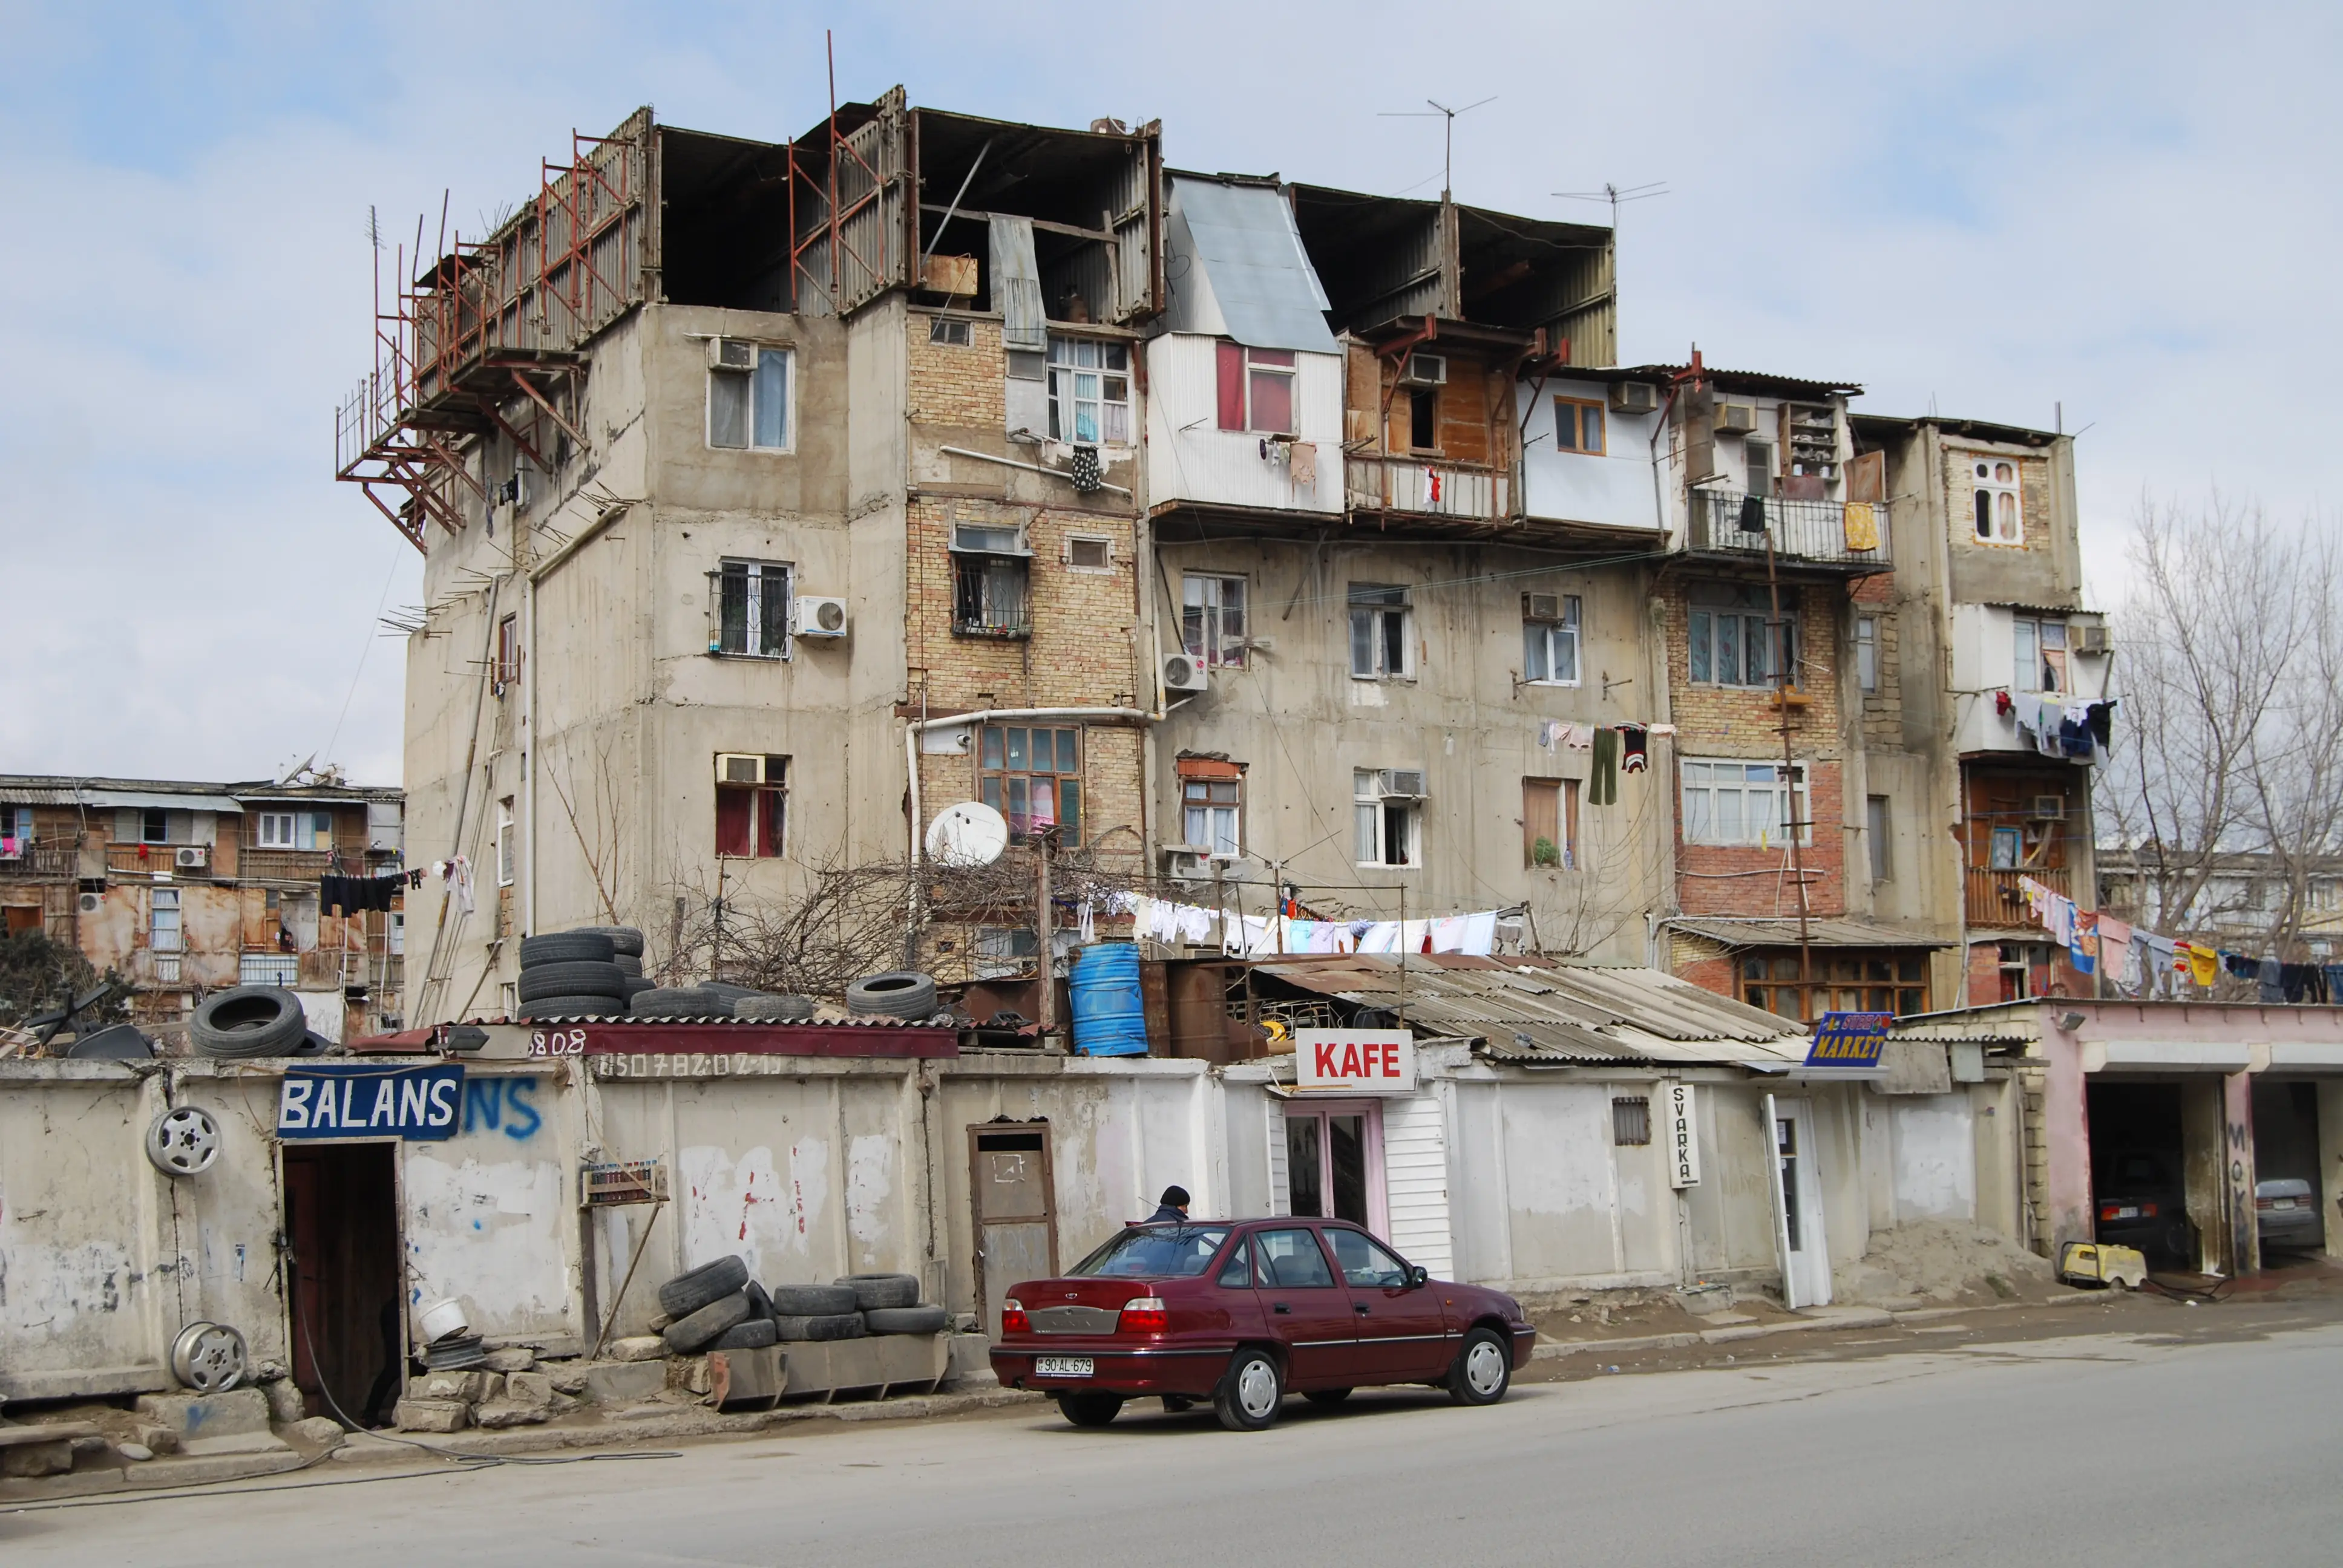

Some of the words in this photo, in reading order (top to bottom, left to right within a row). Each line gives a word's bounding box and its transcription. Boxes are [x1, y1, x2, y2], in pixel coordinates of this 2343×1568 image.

[528, 1029, 586, 1056] 808
[1812, 1035, 1885, 1058] MARKET
[1315, 1044, 1400, 1077] KAFE
[278, 1079, 456, 1128] BALANS
[1673, 1088, 1690, 1177] SVARKA
